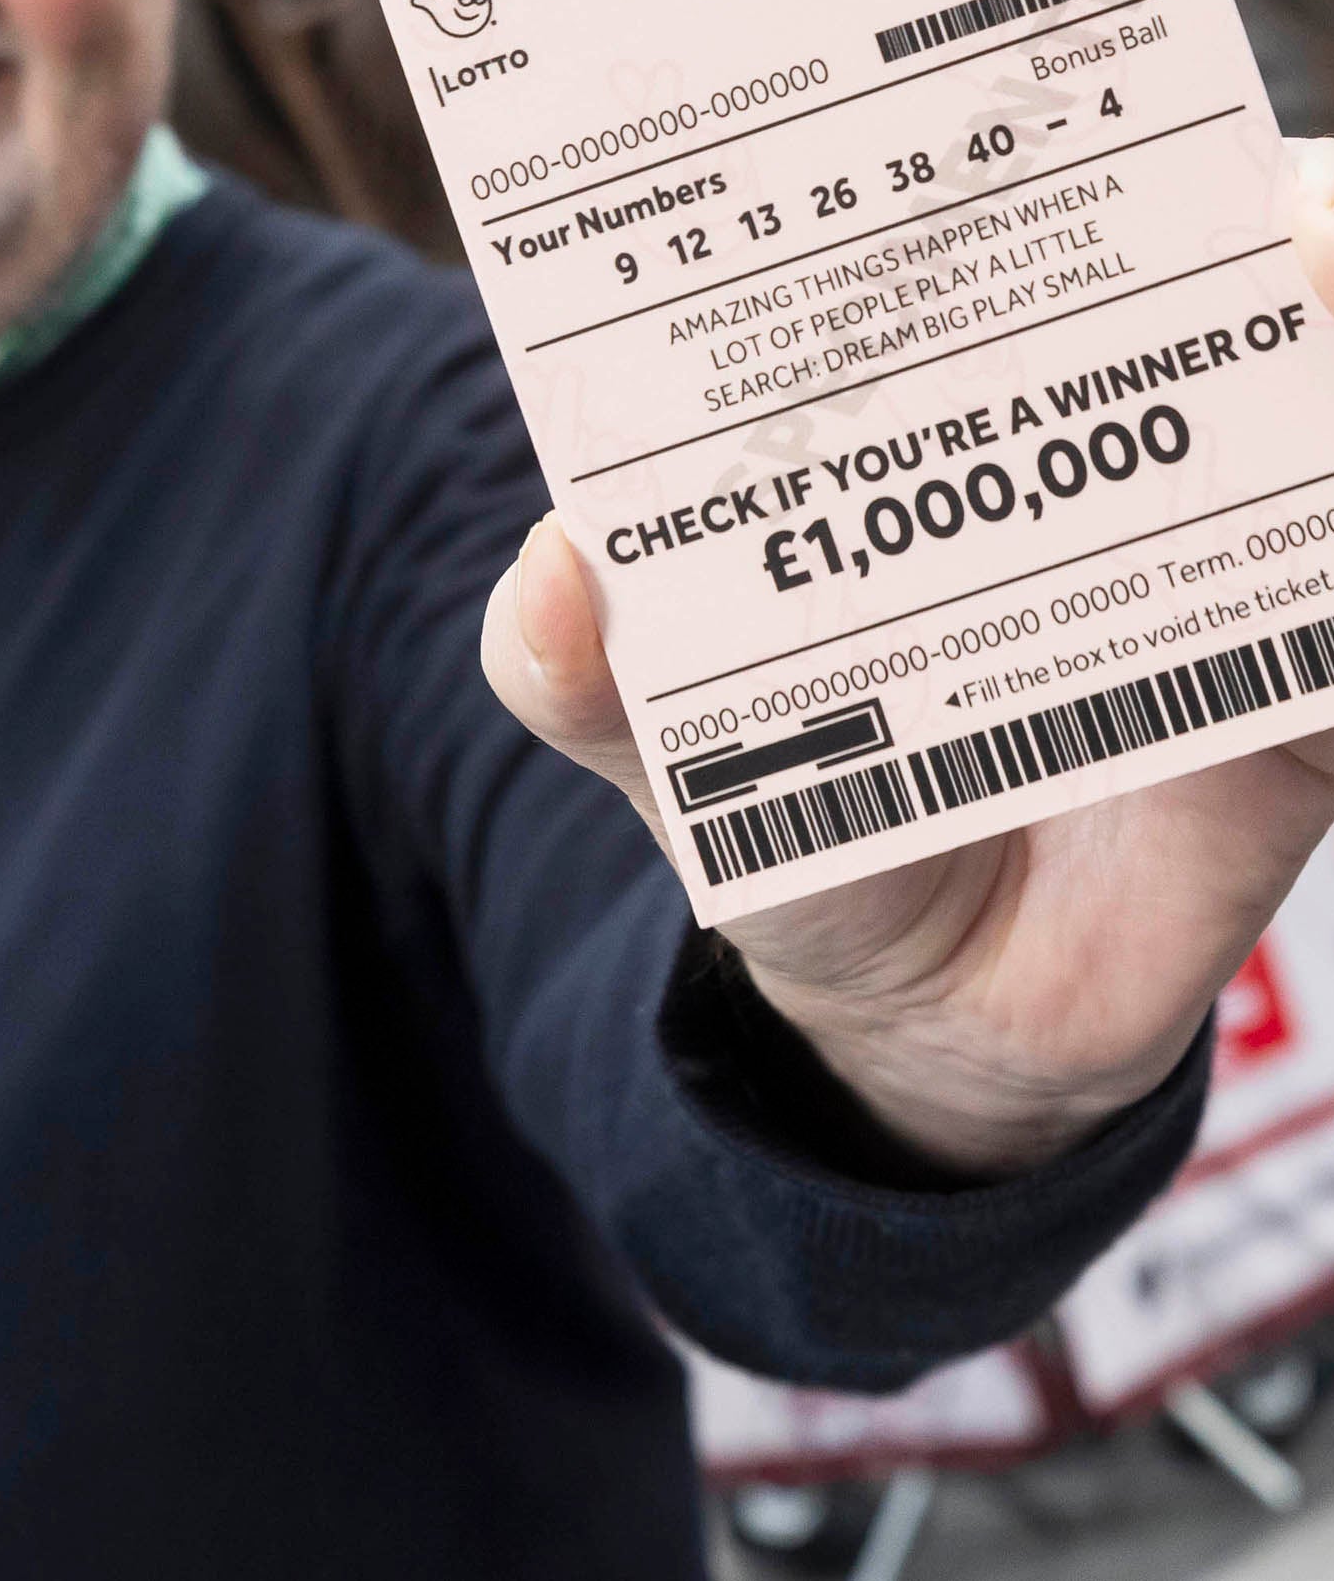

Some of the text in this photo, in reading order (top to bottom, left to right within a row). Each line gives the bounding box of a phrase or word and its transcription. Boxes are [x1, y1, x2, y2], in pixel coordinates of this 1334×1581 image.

[440, 48, 530, 95] LOTTO
[1029, 14, 1169, 82] Bonus Ball
[489, 171, 728, 267] Your Numbers
[613, 251, 640, 286] 9
[665, 226, 714, 266] 12
[736, 201, 783, 242] 13
[808, 176, 859, 220] 26
[883, 150, 937, 194] 38
[966, 123, 1016, 165] 40
[1098, 86, 1125, 119] 4
[669, 173, 1125, 347] AMAZING THINGS HAPPEN WHEN A
[703, 251, 1137, 413] SEARCH: DREAM BIG PLAY SMALL
[709, 219, 1105, 372] LOT OF PEOPLE PLAY A LITTLE
[605, 301, 1307, 566] CHECK IF YOU'RE A WINNER OF
[761, 403, 1192, 594] £1,000,000
[961, 674, 1002, 709] Fill
[1003, 665, 1052, 695] the
[1052, 647, 1107, 679] box
[1107, 636, 1140, 661] to
[1141, 609, 1203, 649] void
[1203, 600, 1252, 629] the
[1049, 571, 1151, 626] 00000
[1156, 550, 1244, 589] Term.
